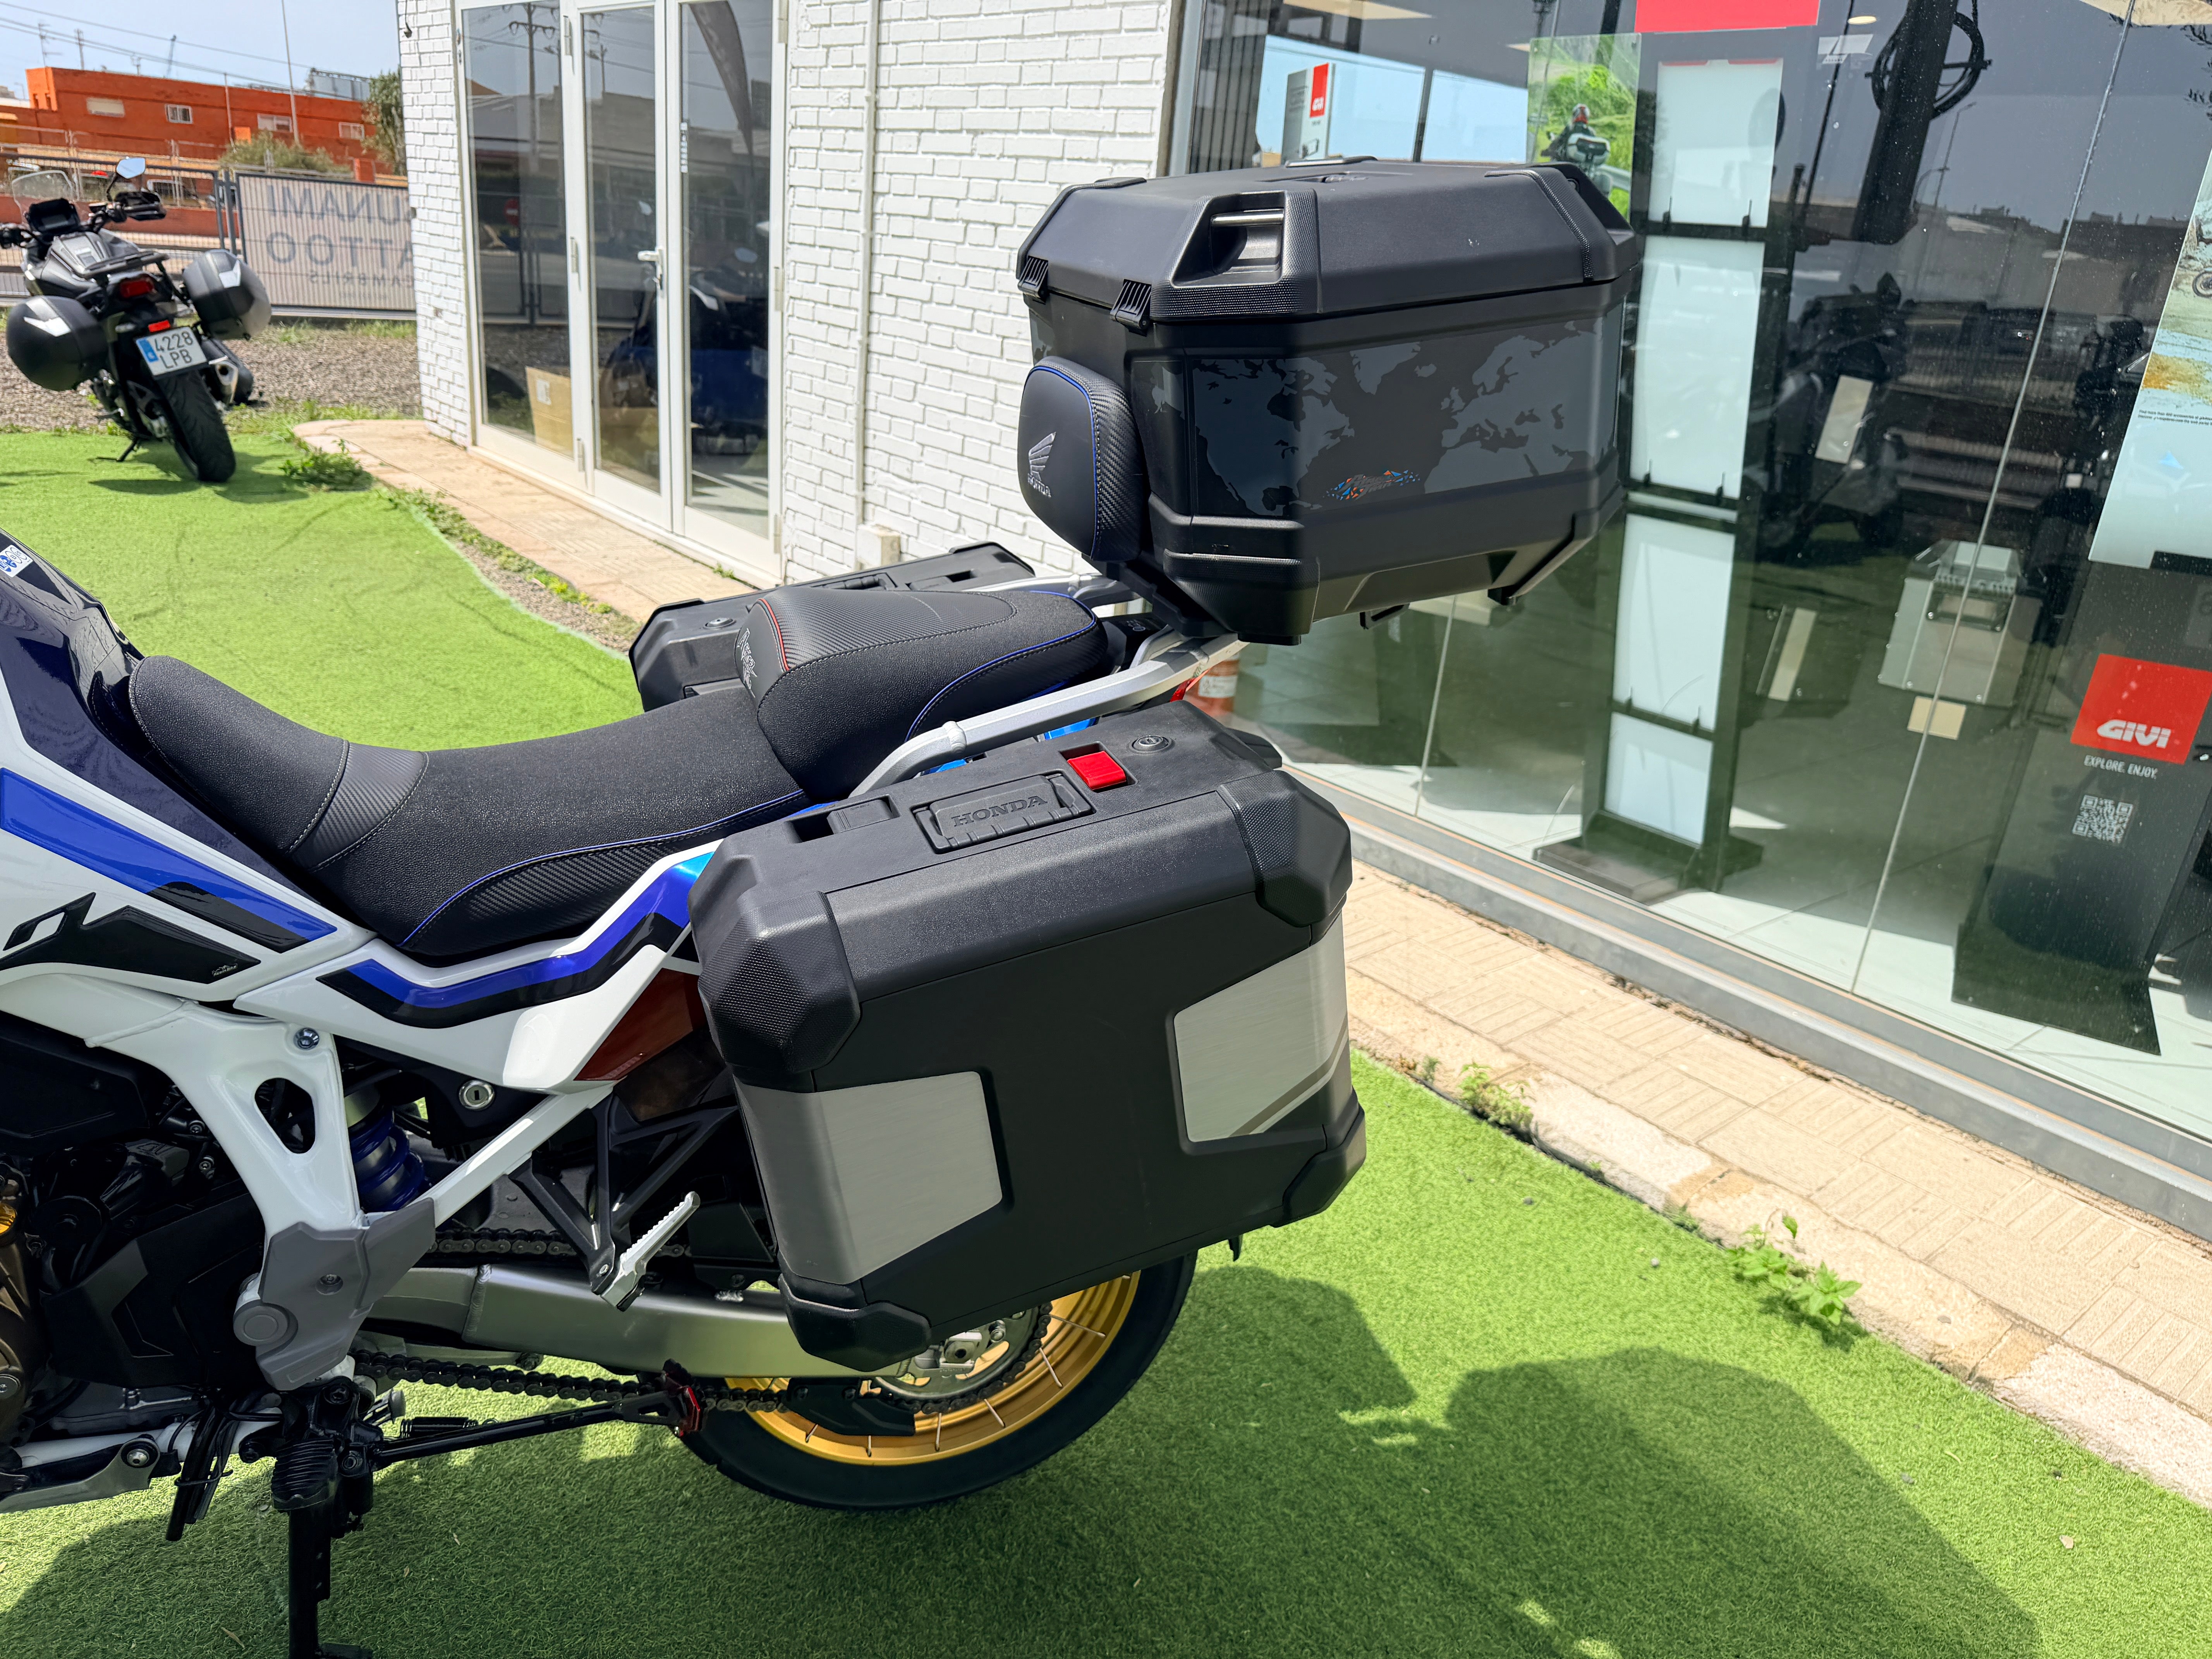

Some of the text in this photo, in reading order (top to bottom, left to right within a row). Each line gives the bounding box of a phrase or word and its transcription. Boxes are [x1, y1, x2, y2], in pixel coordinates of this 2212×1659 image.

[155, 331, 193, 352] 4228
[160, 349, 192, 369] LPB
[2097, 719, 2171, 749] GIVI
[951, 796, 1048, 827] HONDA
